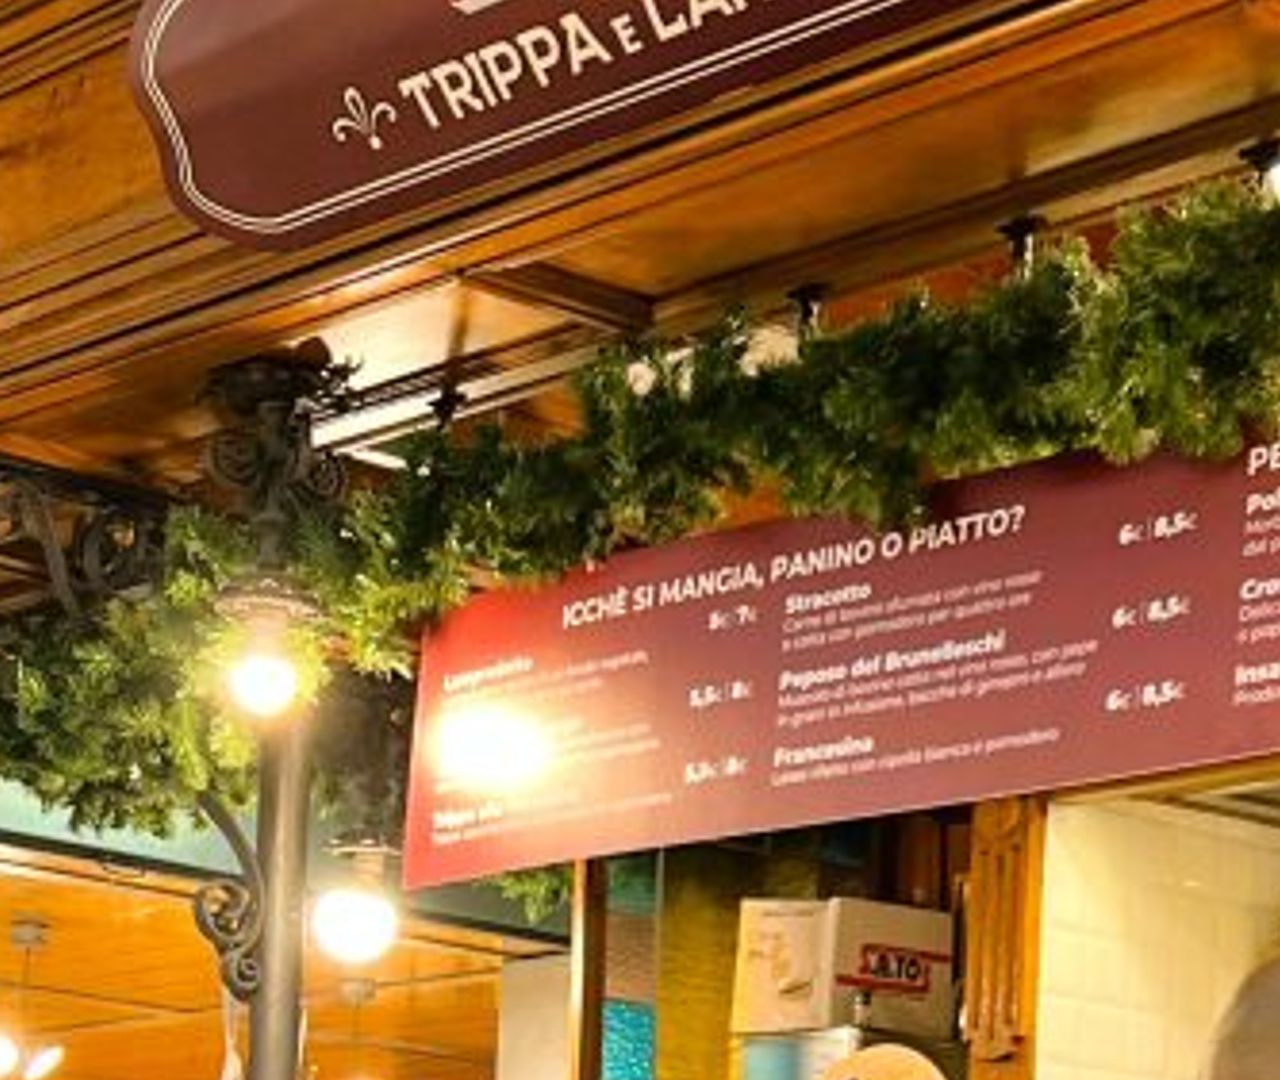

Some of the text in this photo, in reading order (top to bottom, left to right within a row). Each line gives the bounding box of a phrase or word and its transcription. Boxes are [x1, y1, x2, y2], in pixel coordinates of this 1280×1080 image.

[399, 0, 750, 128] TRIPPA E LA
[632, 584, 654, 612] SI
[658, 561, 764, 606] MANGIA,
[769, 537, 875, 583] PANINO
[880, 531, 903, 559] O
[907, 503, 1026, 554] PIATTO?
[784, 582, 872, 615] Stracotto
[777, 664, 848, 691] Peposo
[850, 654, 881, 677] del
[772, 735, 875, 768] Francesina
